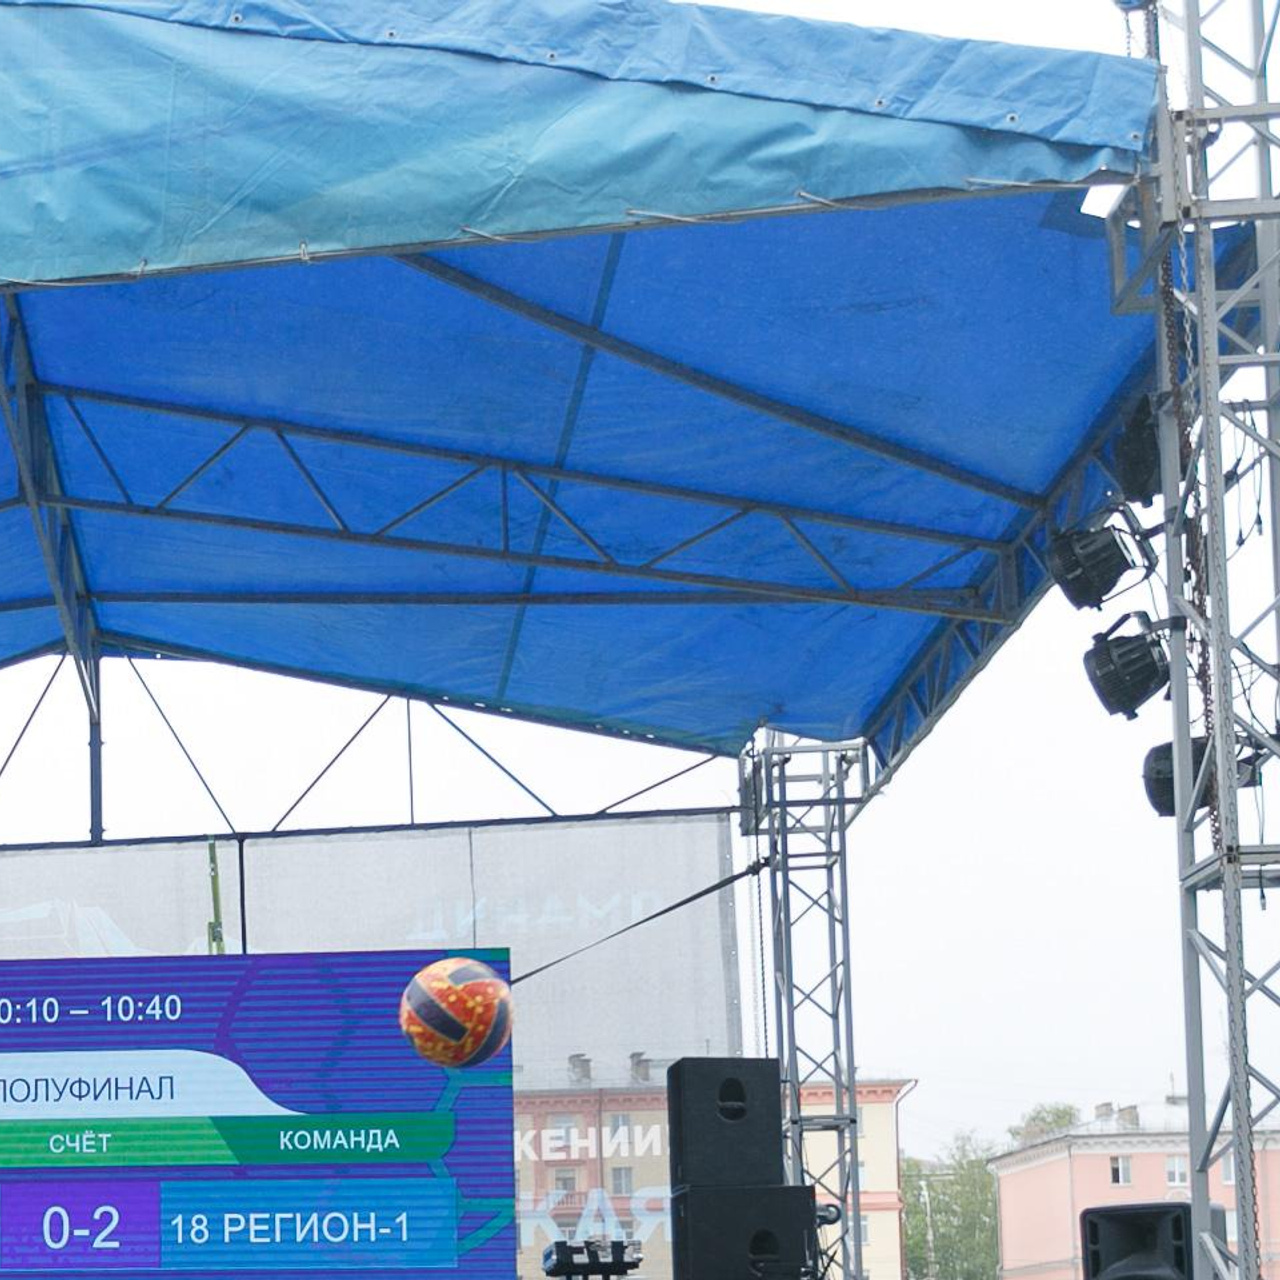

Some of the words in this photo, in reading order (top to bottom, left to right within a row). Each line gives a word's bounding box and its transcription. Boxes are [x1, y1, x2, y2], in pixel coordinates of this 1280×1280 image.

[101, 994, 182, 1022] 10:40
[48, 1130, 112, 1155] СЧЁТ
[278, 1128, 400, 1152] КОМАНДА
[42, 1205, 120, 1250] 0-2
[170, 1215, 210, 1244] 18
[223, 1212, 408, 1243] РЕГИОН-1
